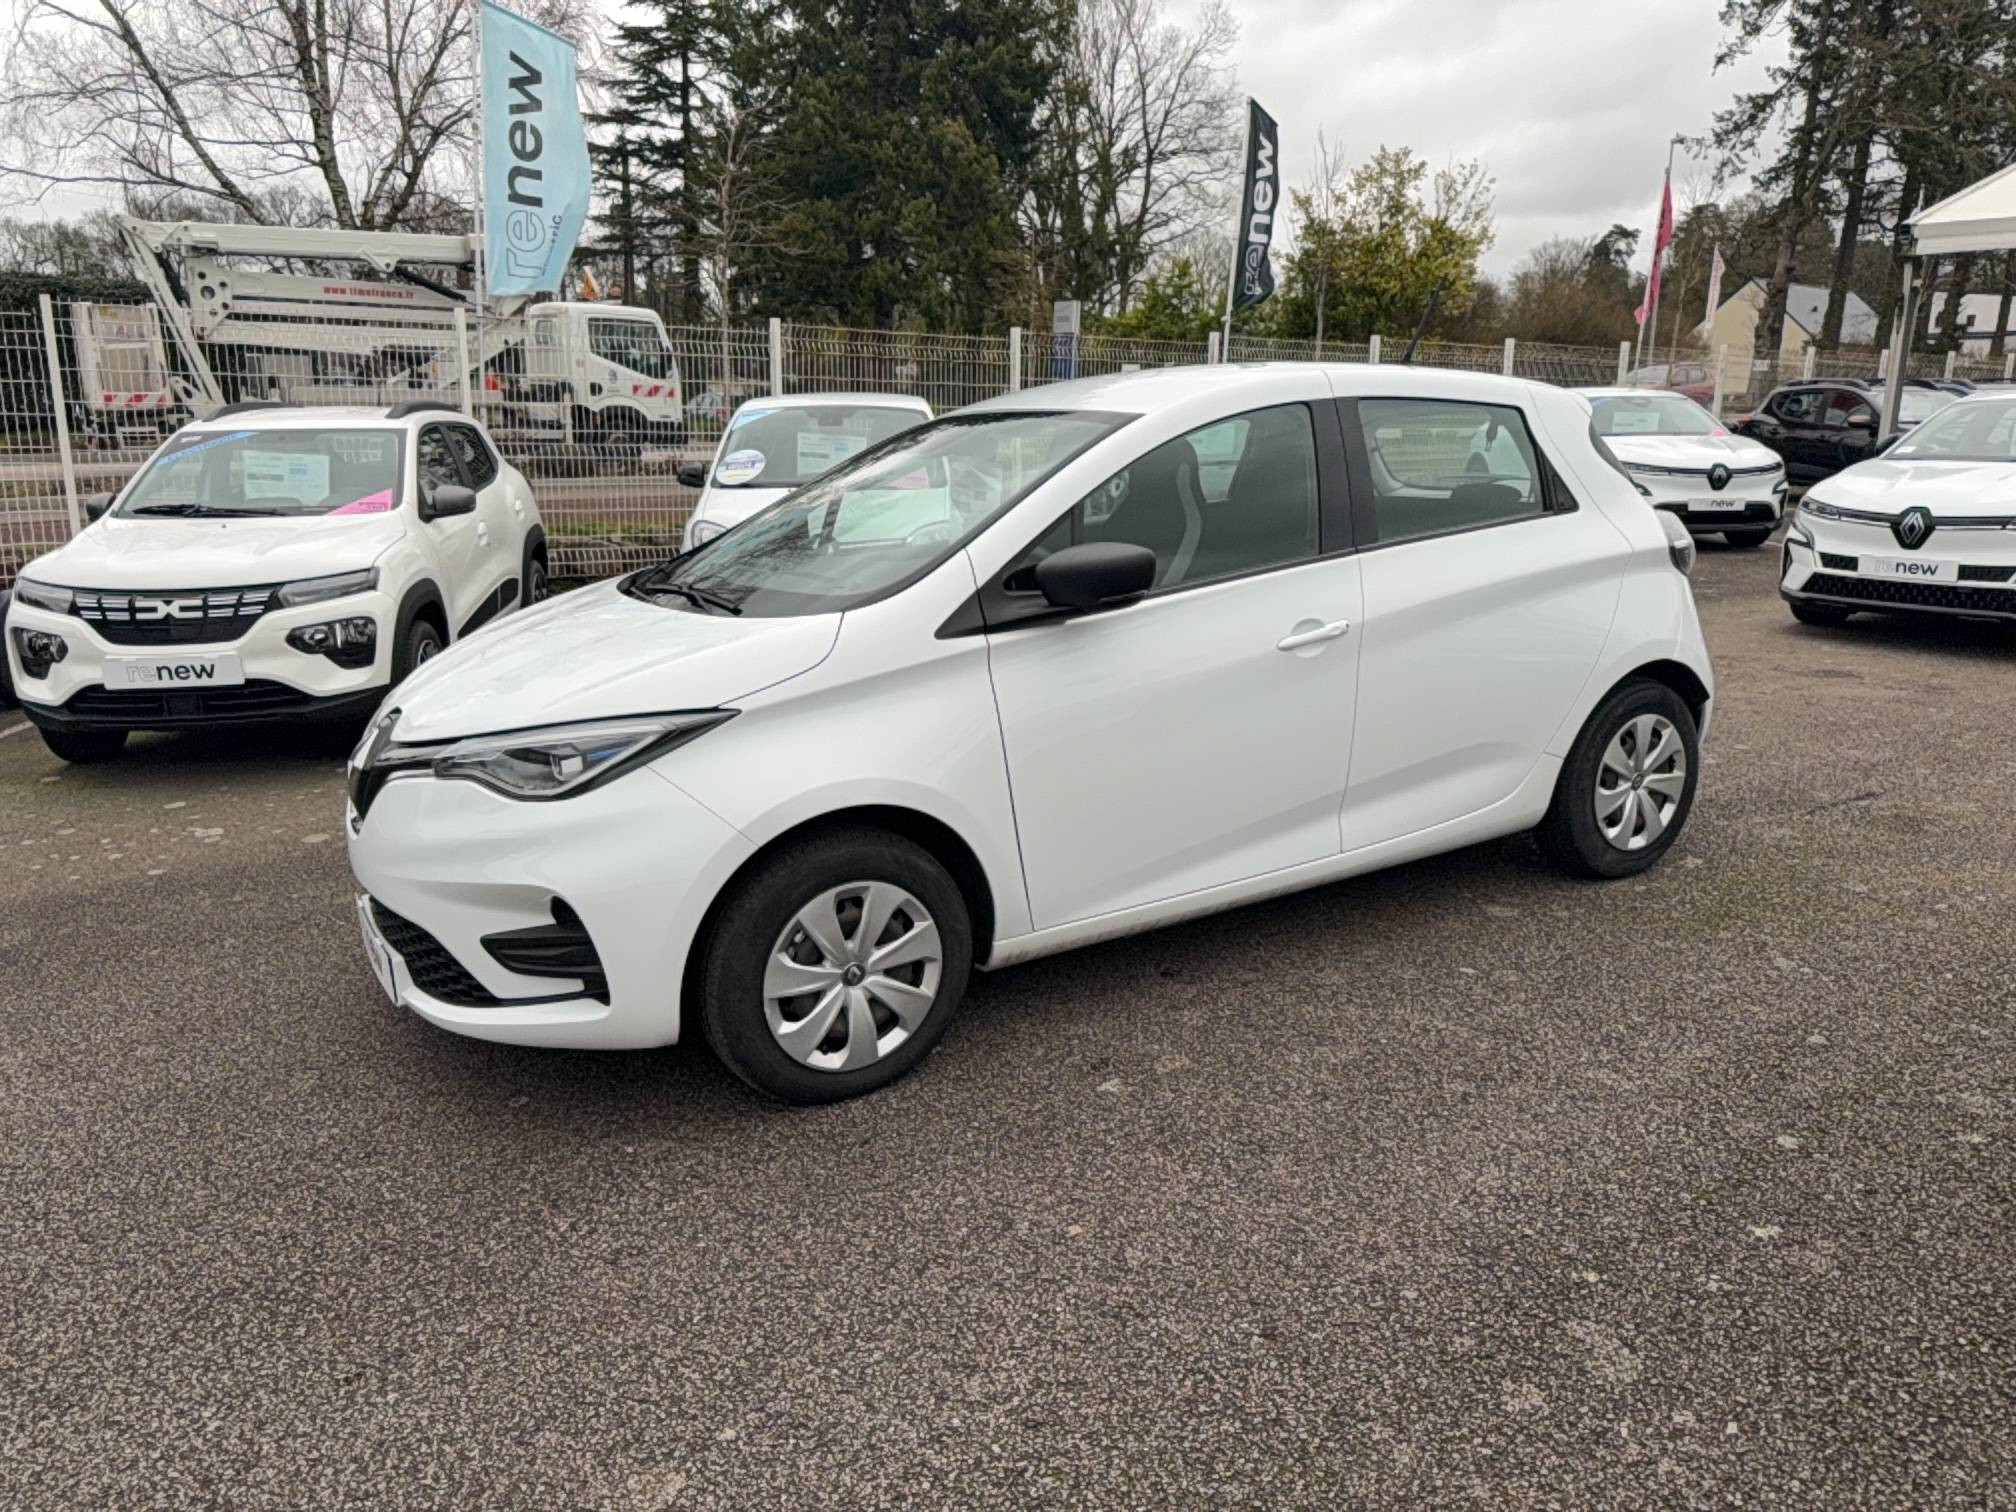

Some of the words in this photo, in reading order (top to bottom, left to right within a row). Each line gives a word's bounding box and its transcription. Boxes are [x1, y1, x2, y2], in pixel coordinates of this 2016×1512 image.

[506, 50, 545, 279] renew
[1244, 133, 1273, 295] renew
[127, 664, 215, 682] renew
